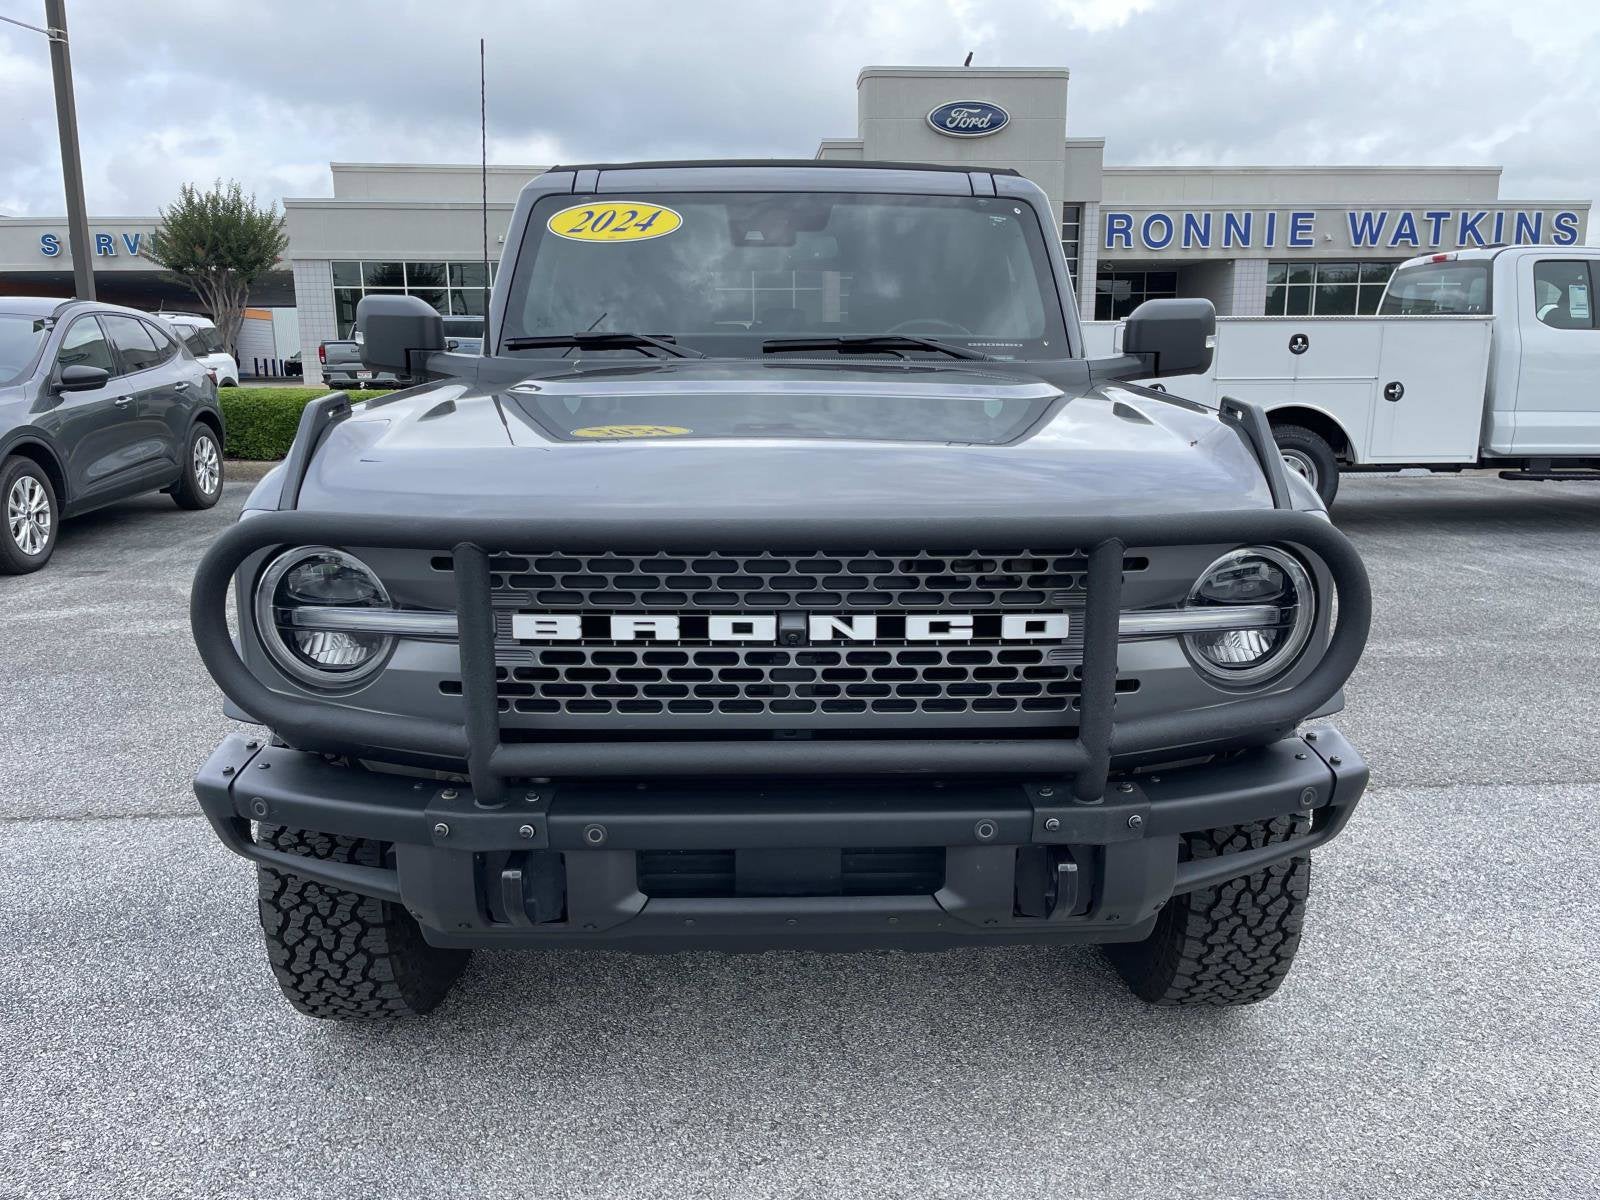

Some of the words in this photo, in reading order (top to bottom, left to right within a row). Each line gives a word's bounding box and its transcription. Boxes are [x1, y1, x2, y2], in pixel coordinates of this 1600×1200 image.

[945, 108, 992, 128] Ford
[566, 209, 662, 233] 2024
[1104, 211, 1317, 250] RONNIE
[1348, 211, 1579, 247] WATKINS
[512, 614, 1070, 641] BRONCO
